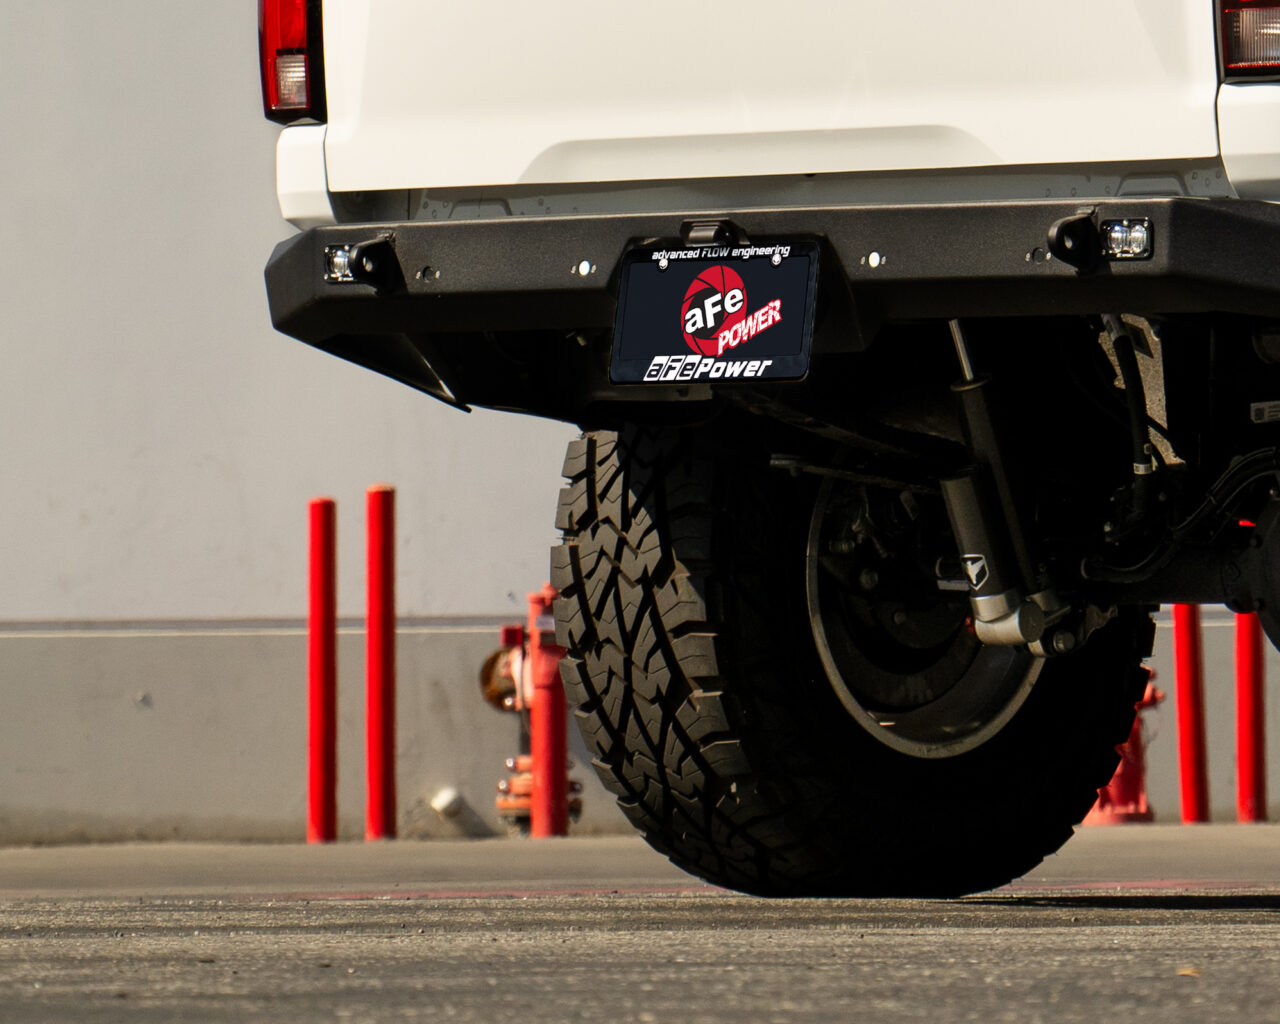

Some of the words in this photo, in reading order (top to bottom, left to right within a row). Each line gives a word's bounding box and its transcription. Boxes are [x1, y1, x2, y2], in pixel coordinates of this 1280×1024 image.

[652, 248, 700, 260] advanced
[701, 247, 730, 258] FLOW
[732, 245, 791, 258] engineering
[684, 287, 744, 335] aFe
[716, 298, 783, 358] POWER
